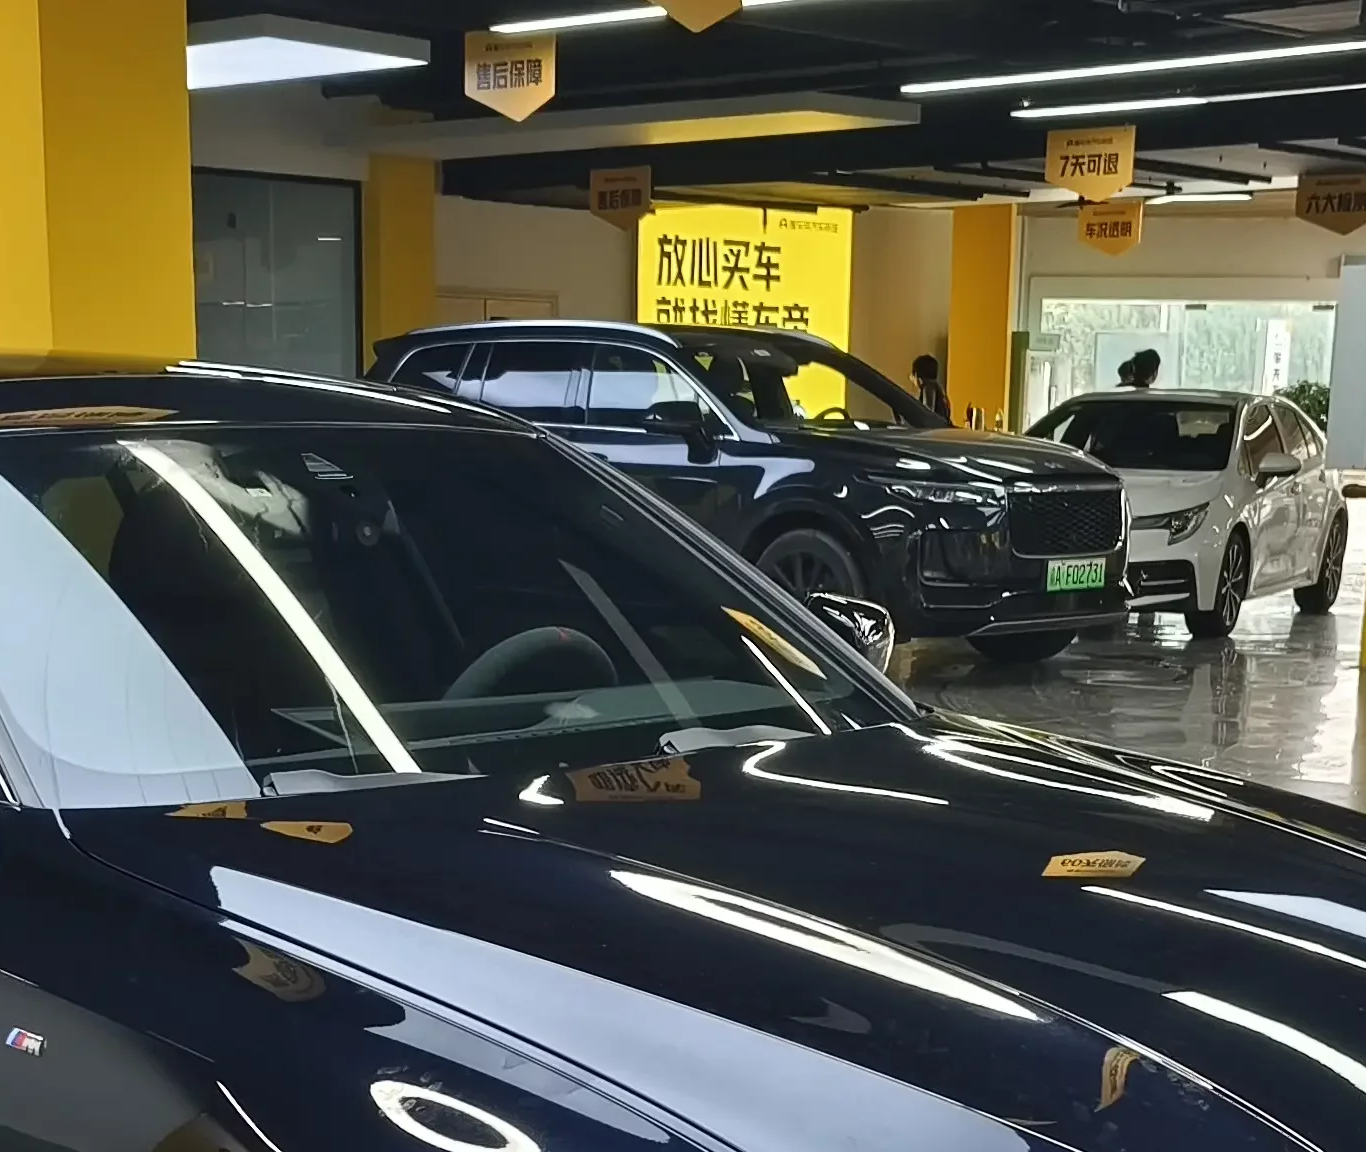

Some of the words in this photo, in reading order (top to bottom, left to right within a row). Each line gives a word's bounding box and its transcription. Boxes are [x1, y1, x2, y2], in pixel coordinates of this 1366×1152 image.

[476, 58, 542, 90] 售后保障
[1059, 152, 1119, 177] 7天可退
[1085, 220, 1133, 239] 车况透明
[656, 234, 782, 292] 放心买车
